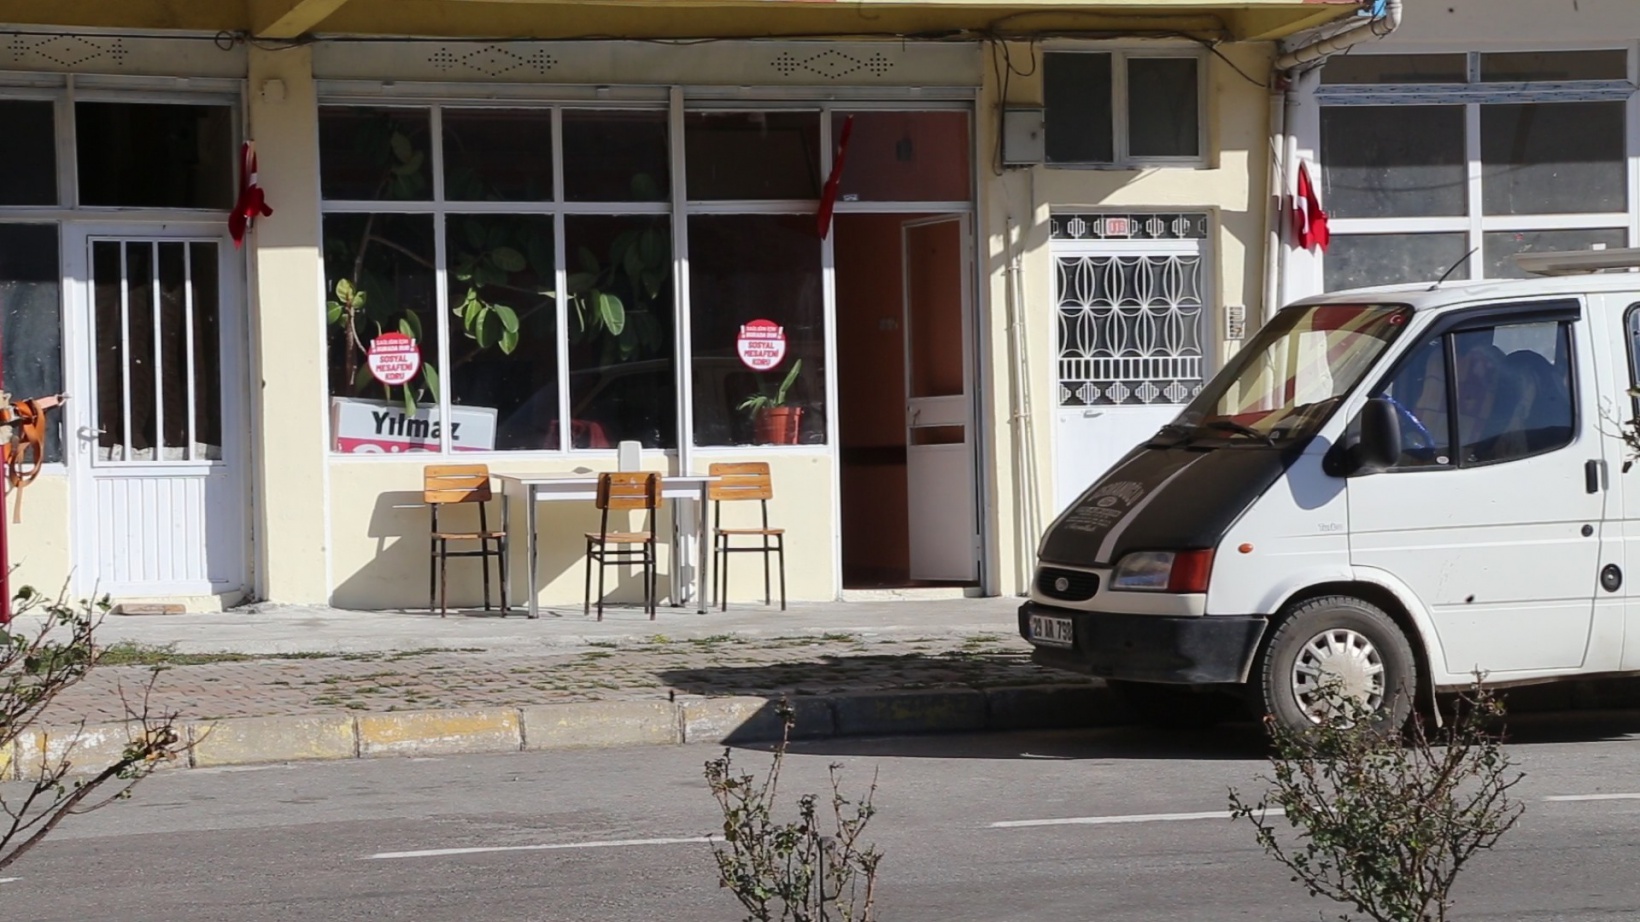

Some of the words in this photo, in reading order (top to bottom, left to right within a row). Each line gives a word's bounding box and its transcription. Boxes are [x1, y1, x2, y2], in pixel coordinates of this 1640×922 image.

[748, 341, 775, 349] SOSYAL
[379, 355, 408, 363] SOSYAL
[376, 362, 413, 372] MESAFENİ
[371, 411, 461, 441] Yılmaz
[1033, 617, 1042, 637] 29
[1044, 619, 1054, 638] AR
